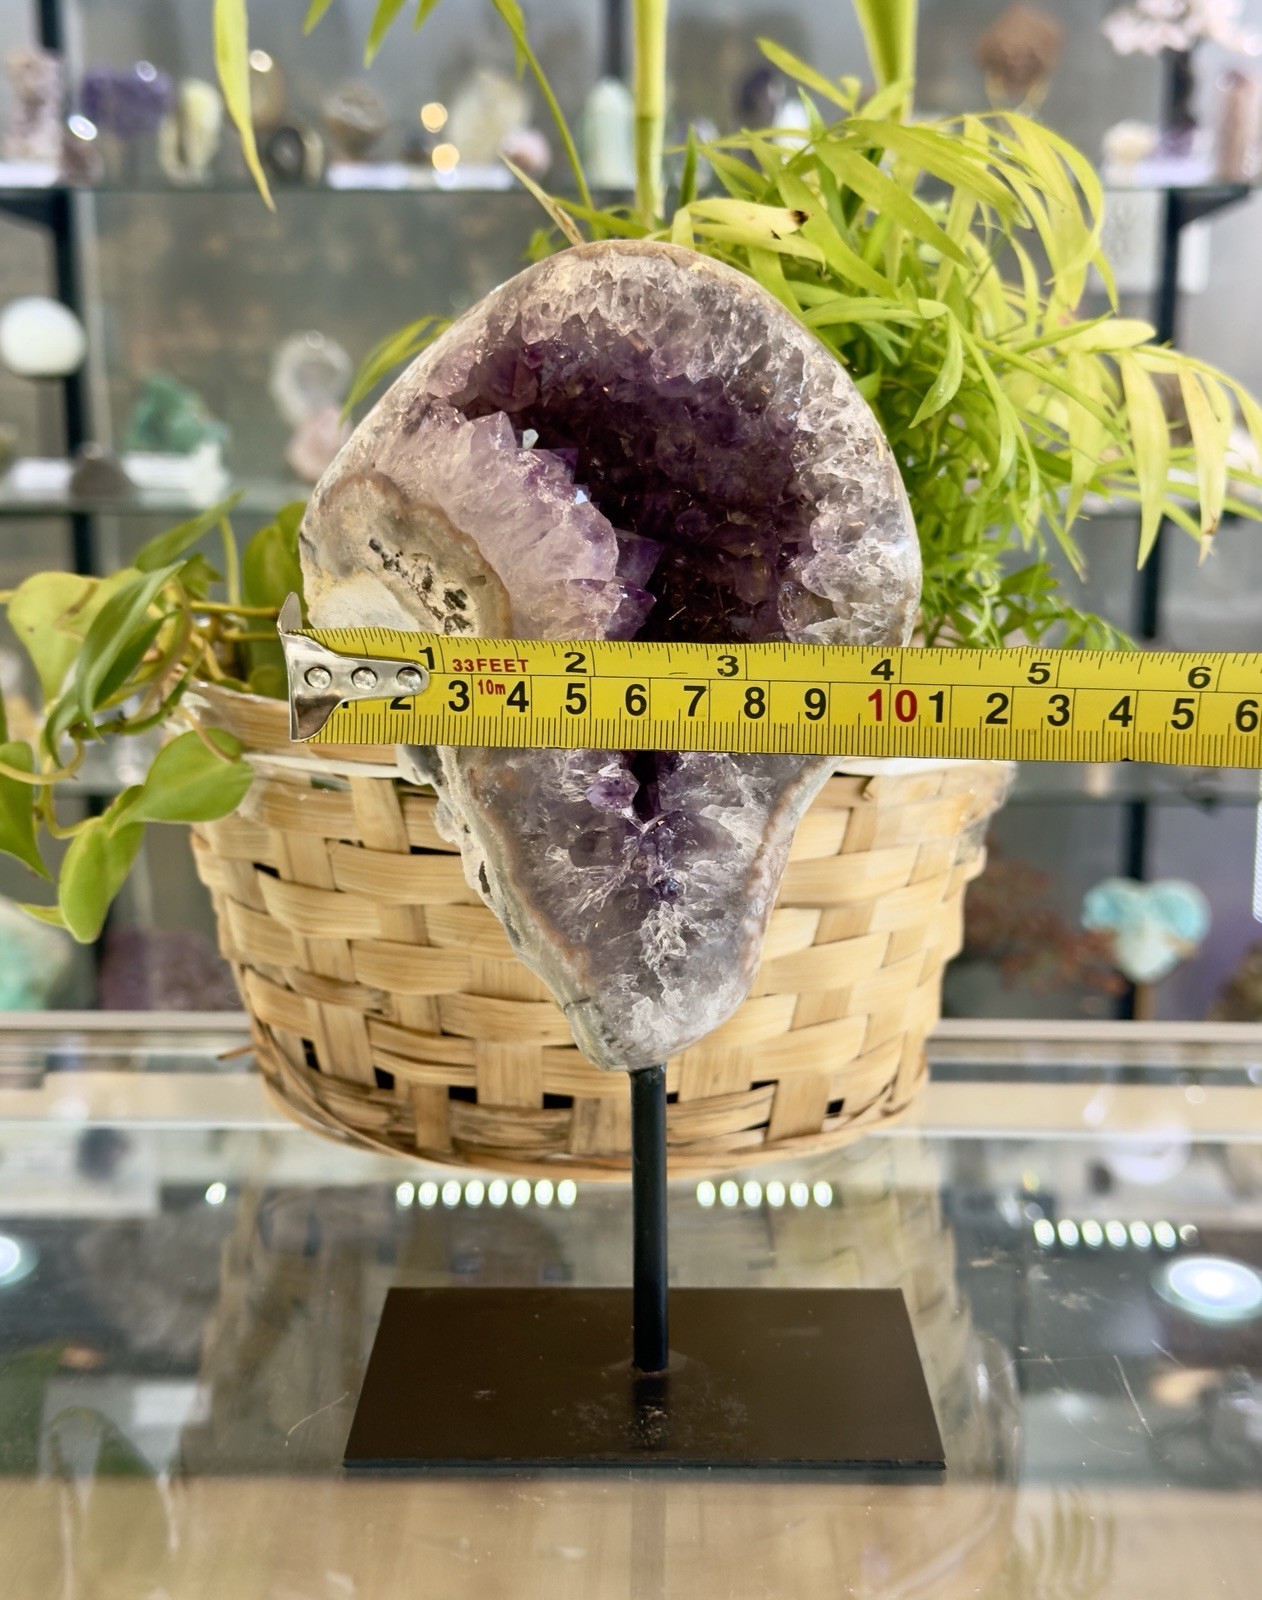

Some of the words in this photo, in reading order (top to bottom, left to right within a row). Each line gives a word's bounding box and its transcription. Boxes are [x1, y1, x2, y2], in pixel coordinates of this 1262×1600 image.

[419, 646, 436, 670] 1
[565, 651, 587, 674] 2
[716, 655, 739, 677] 3
[870, 658, 895, 681] 4
[1026, 662, 1051, 685] 5
[1187, 666, 1212, 689] 6
[477, 678, 506, 696] 10m
[448, 680, 470, 713] 3
[506, 681, 530, 713] 4
[565, 683, 587, 715] 5
[625, 684, 648, 717] 6
[683, 685, 707, 718] 7
[743, 686, 766, 719] 8
[804, 688, 827, 721] 9
[867, 688, 918, 723] 10
[928, 691, 945, 723] 1
[985, 692, 1010, 725] 2
[1047, 694, 1071, 727] 3
[1108, 695, 1133, 728] 4
[1170, 697, 1195, 730] 5
[1235, 699, 1260, 733] 6
